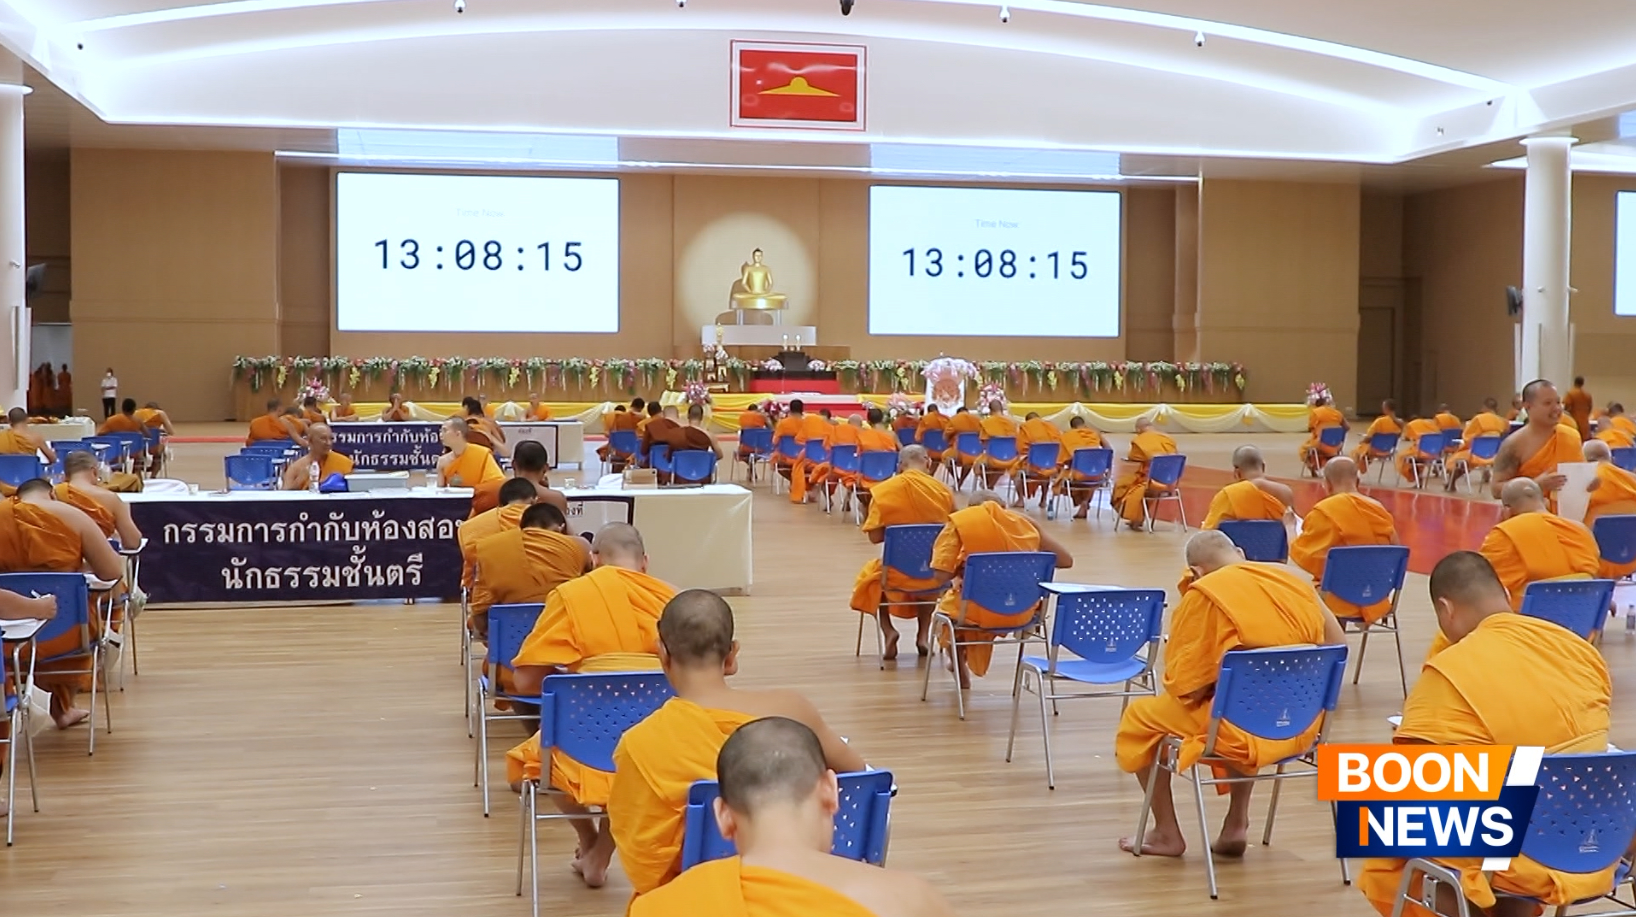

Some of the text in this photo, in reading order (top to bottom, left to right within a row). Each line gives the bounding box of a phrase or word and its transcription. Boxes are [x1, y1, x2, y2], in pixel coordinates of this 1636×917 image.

[457, 208, 480, 217] Time
[974, 218, 1020, 228] Time Now
[374, 238, 583, 272] 13:08:15
[902, 247, 1088, 280] 13:08:15
[221, 545, 424, 590] นักธรรมชั้นตรี
